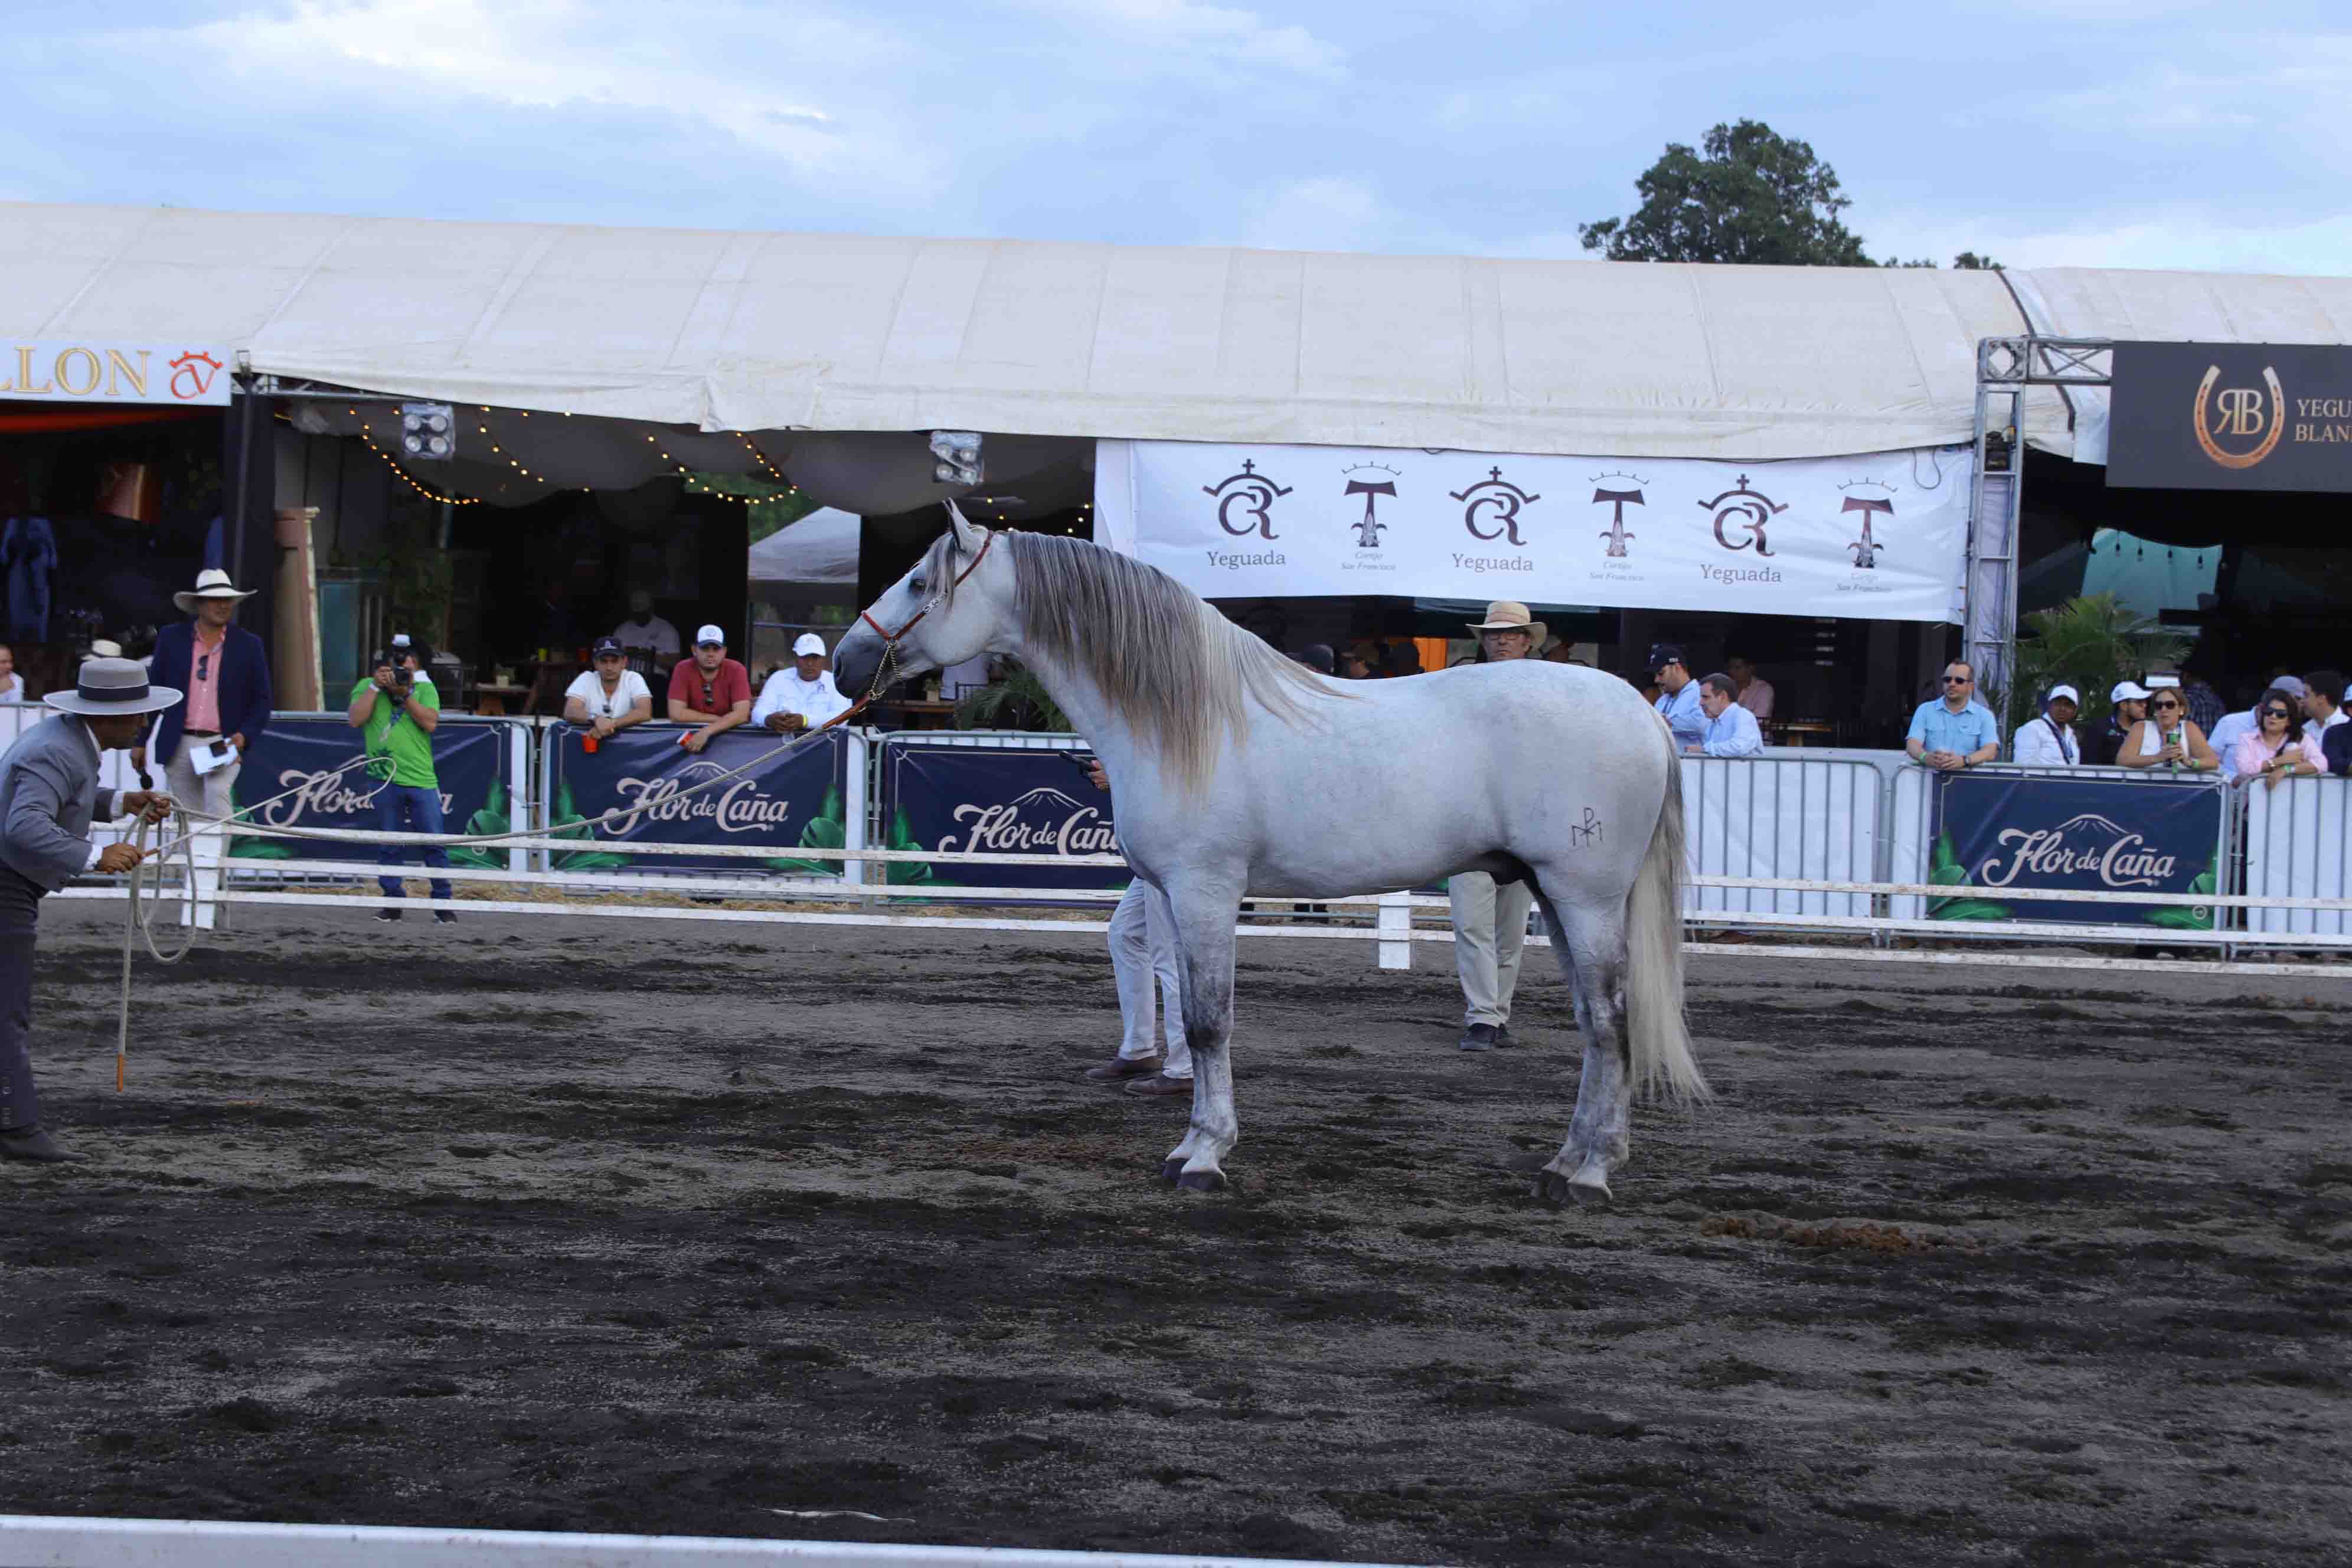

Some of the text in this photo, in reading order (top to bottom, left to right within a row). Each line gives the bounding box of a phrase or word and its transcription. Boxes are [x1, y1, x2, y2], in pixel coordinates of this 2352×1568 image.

[0, 345, 152, 397] LON
[1207, 549, 1286, 570] Yeguada
[1452, 553, 1534, 573] Yeguada
[1700, 564, 1782, 584] Yeguada
[602, 778, 789, 835] Flor de Caña
[937, 803, 1032, 855] Flor
[1033, 821, 1057, 845] de
[1982, 828, 2176, 887] Flor de Caña
